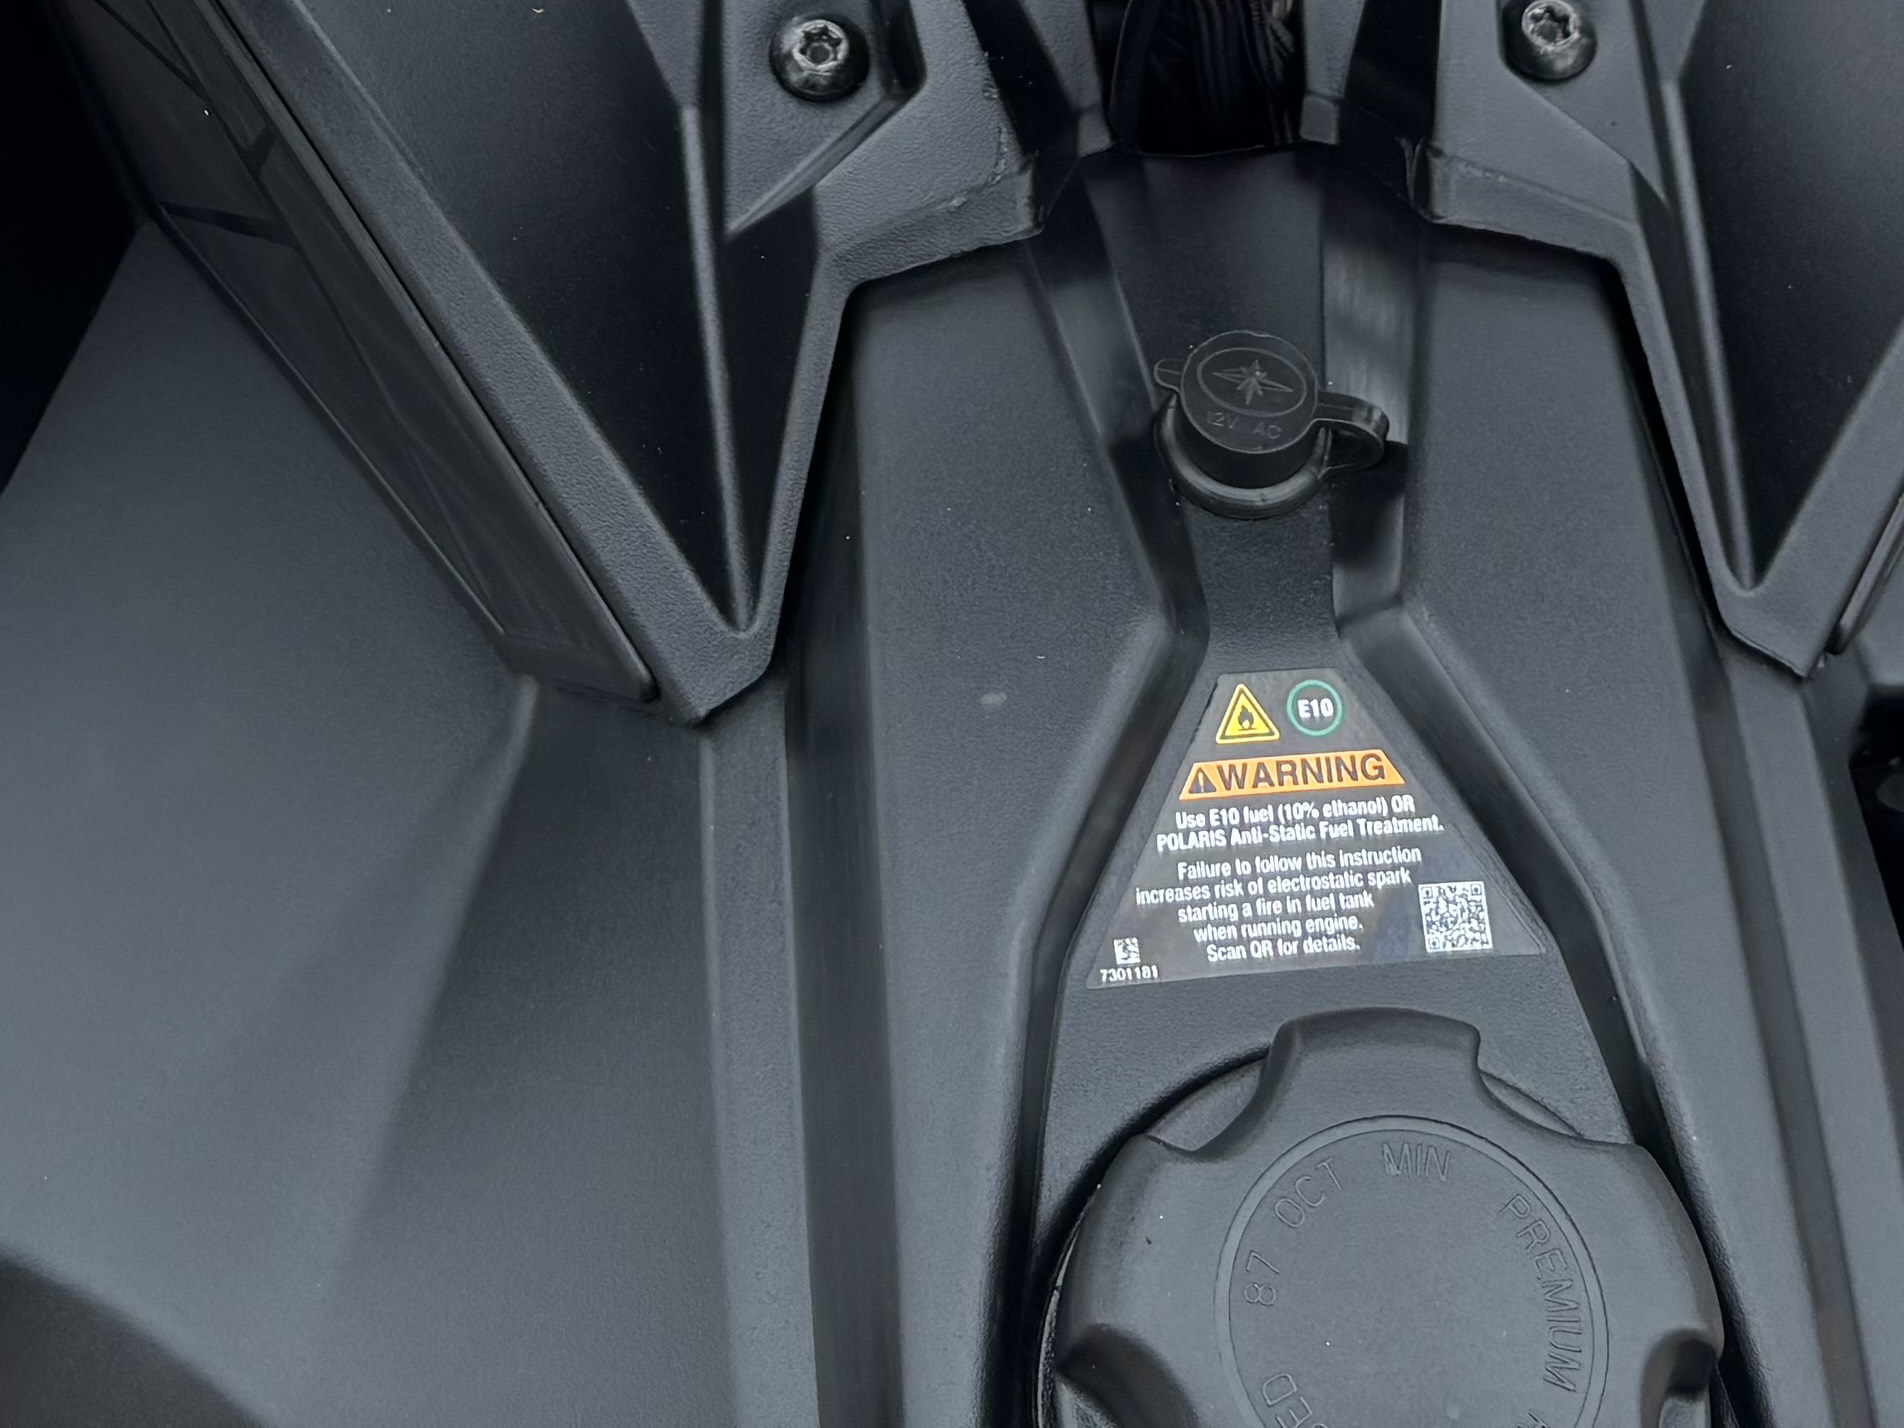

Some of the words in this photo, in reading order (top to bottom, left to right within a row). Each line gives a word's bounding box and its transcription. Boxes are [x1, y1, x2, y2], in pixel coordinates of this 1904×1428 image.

[1297, 698, 1334, 719] E10
[1217, 752, 1387, 791] WARNING
[1176, 811, 1206, 829] Use
[1209, 807, 1240, 826] E10
[1243, 804, 1274, 824] fuel
[1277, 802, 1320, 825] (10%
[1322, 795, 1389, 819] ethanol)
[1391, 794, 1416, 814] OR
[1156, 828, 1227, 852] POLARIS
[1230, 823, 1316, 846] Anti-Static
[1319, 819, 1355, 840] Fuel
[1356, 814, 1444, 837] Treatment.
[1177, 861, 1232, 880] Failure
[1235, 858, 1251, 876] to
[1255, 855, 1302, 874] follow
[1306, 850, 1336, 870] this
[1339, 845, 1422, 867] instruction
[1136, 884, 1211, 905] increases
[1214, 878, 1244, 898] risk
[1247, 876, 1264, 895] of
[1268, 870, 1364, 893] electrostatic
[1367, 866, 1413, 890] spark
[1178, 902, 1239, 923] starting
[1241, 902, 1253, 917] a
[1256, 897, 1283, 917] fire
[1286, 894, 1302, 913] in
[1305, 892, 1335, 912] fuel
[1339, 890, 1375, 910] tank
[1193, 922, 1238, 943] when
[1241, 917, 1302, 940] running
[1305, 914, 1364, 937] engine.
[1206, 944, 1247, 963] Scan
[1250, 941, 1274, 960] QR
[1277, 939, 1300, 957] for
[1303, 935, 1361, 955] details.
[1243, 1249, 1282, 1307] 87
[1273, 1157, 1344, 1229] OCT
[1380, 1142, 1453, 1183] MIN
[1498, 1194, 1585, 1394] PREMIUM
